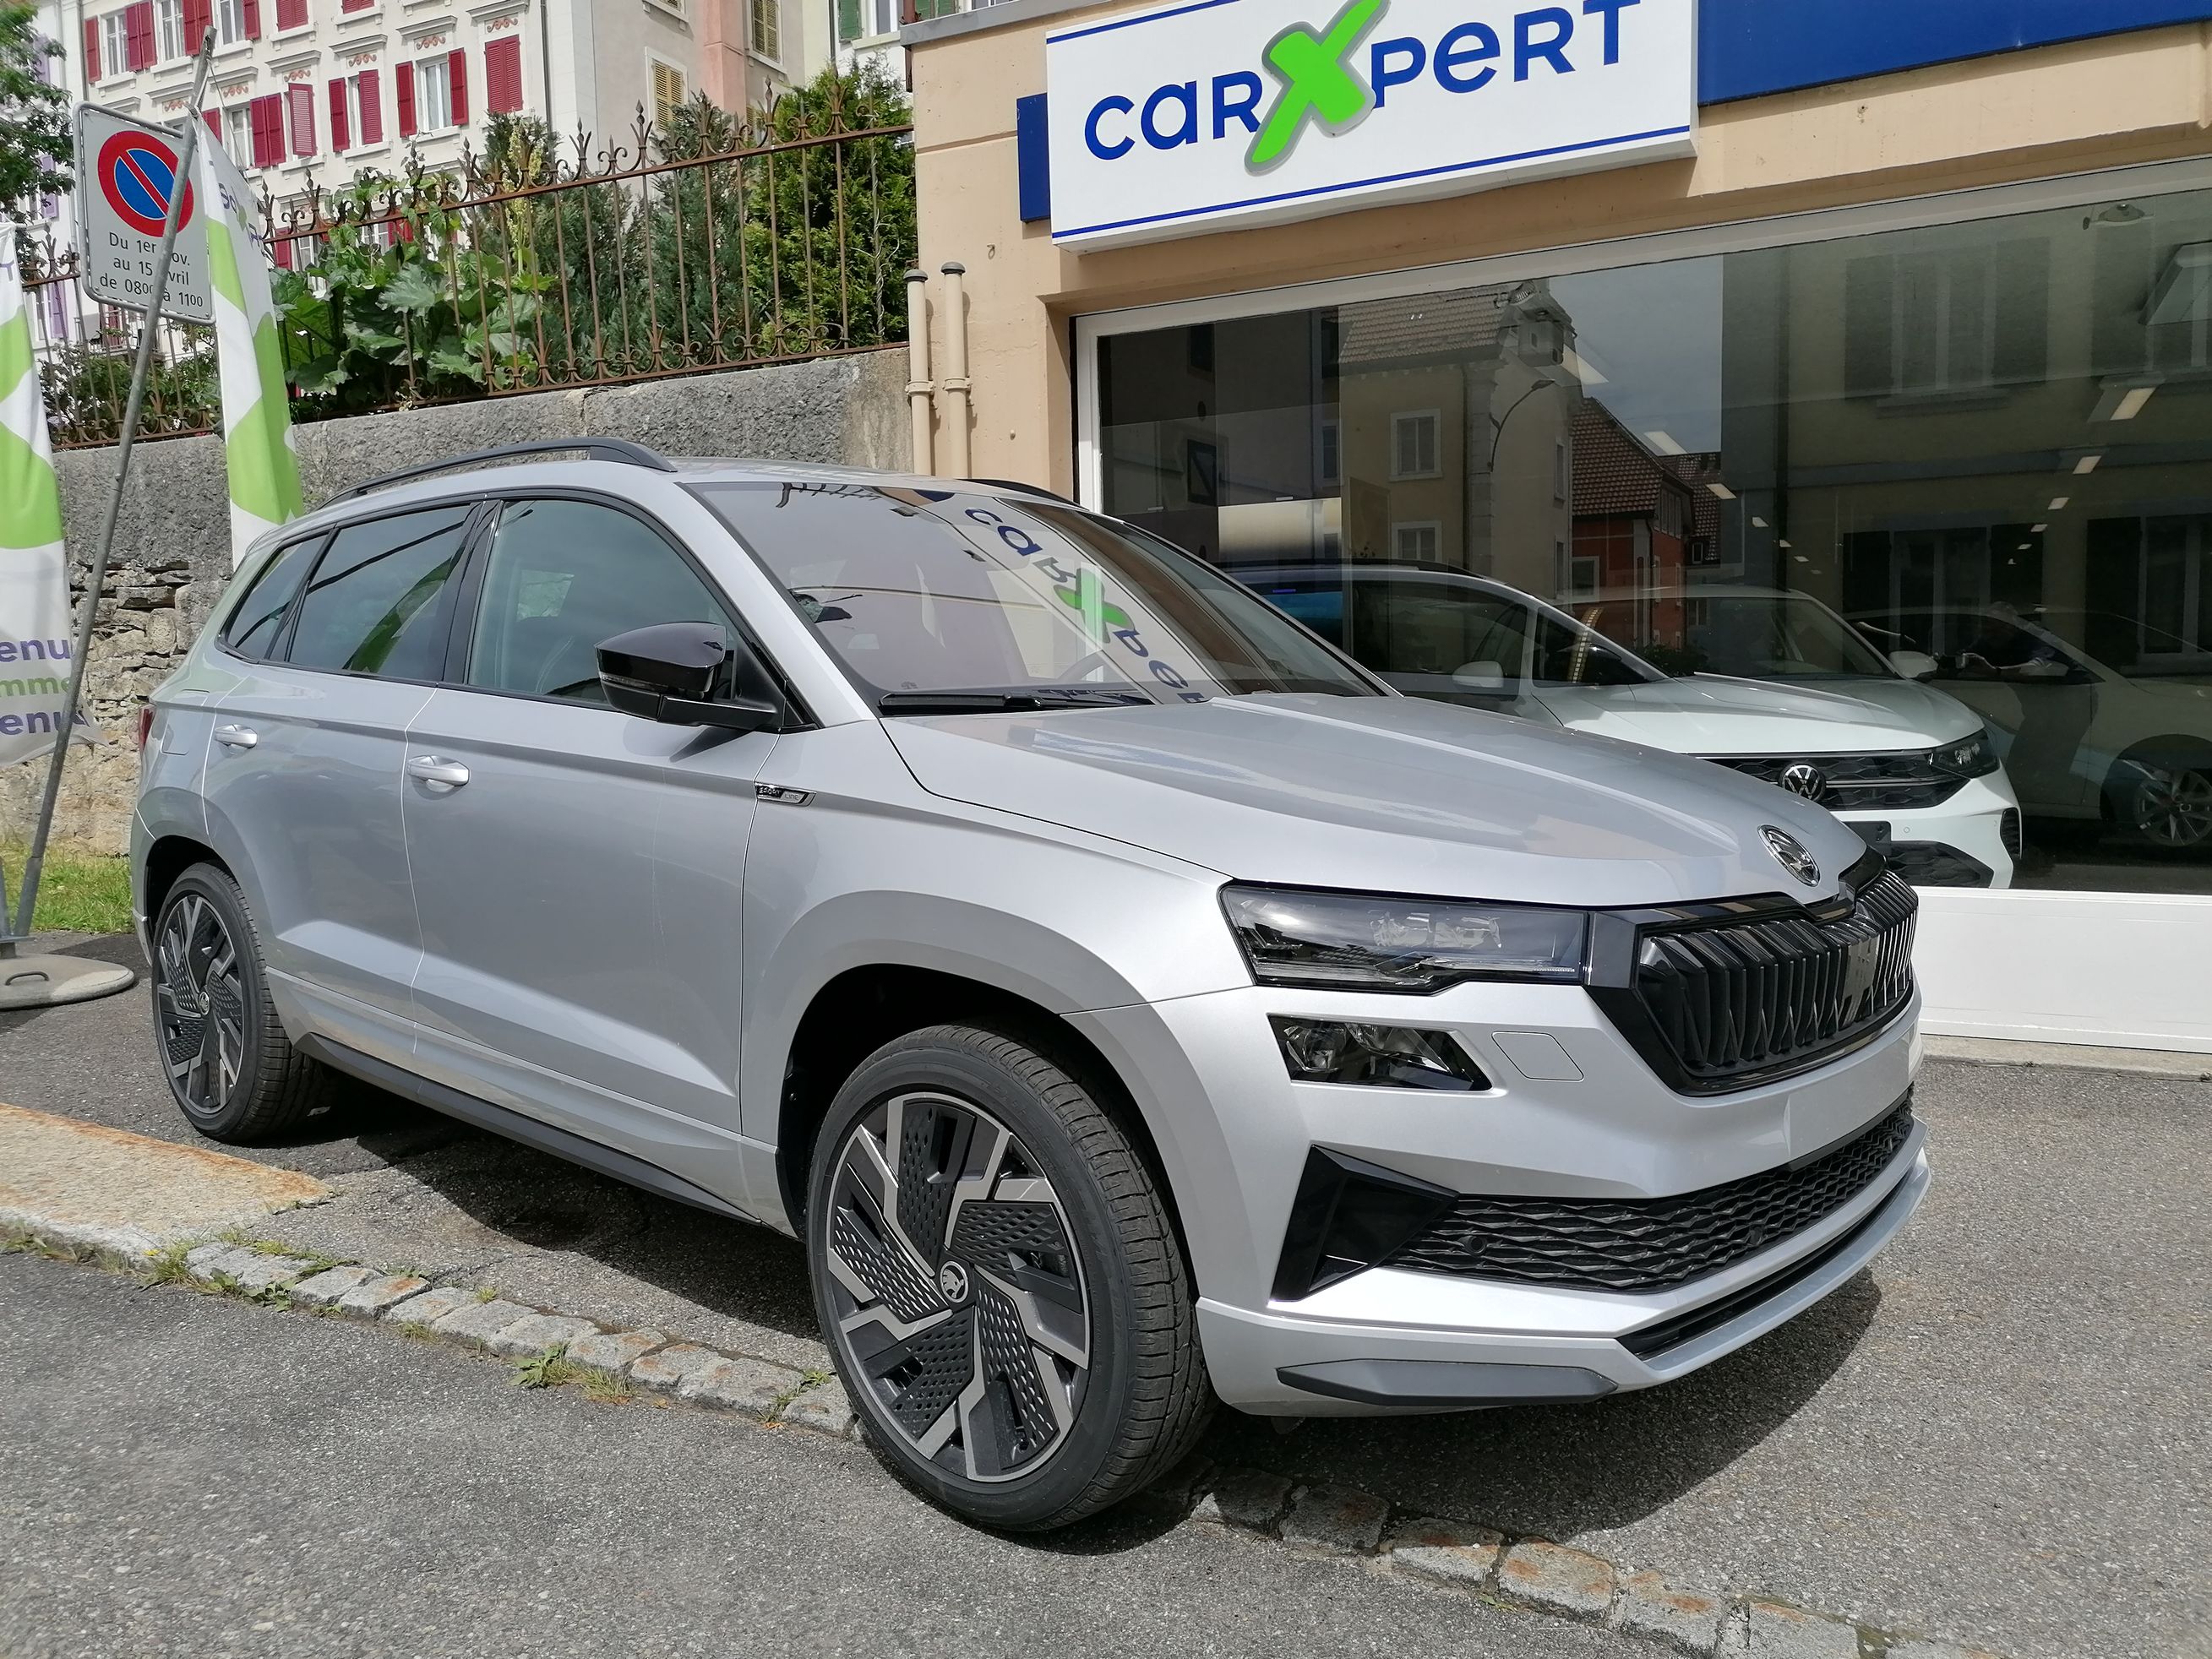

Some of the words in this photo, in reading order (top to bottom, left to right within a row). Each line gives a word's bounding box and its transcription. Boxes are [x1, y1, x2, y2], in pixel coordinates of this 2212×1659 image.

[109, 231, 128, 250] Du
[136, 239, 156, 253] 1er
[172, 252, 190, 266] ov.
[113, 257, 130, 271] au
[139, 261, 153, 276] 15
[168, 270, 189, 286] vril
[100, 273, 117, 289] de
[163, 286, 171, 302] à
[178, 291, 203, 307] 1100
